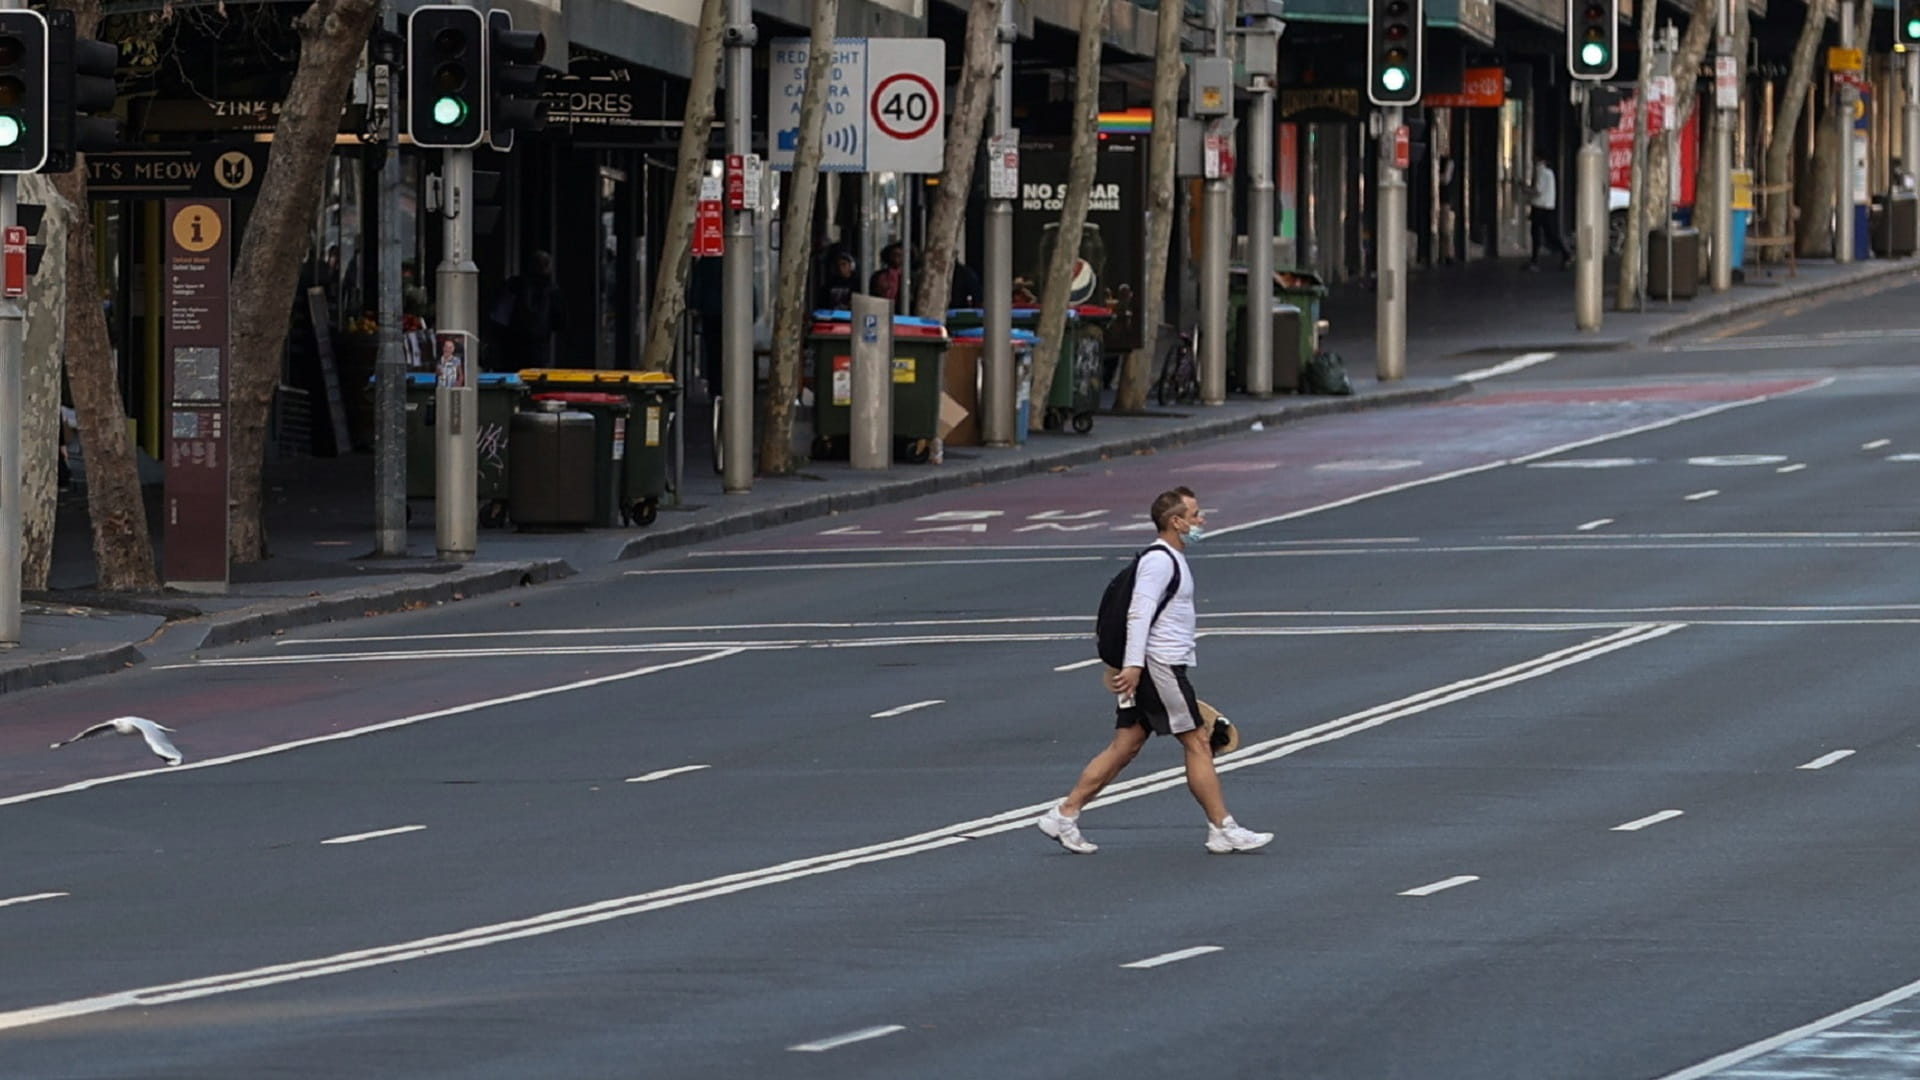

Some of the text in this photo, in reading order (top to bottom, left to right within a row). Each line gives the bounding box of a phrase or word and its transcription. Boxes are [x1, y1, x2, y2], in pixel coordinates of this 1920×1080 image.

[777, 51, 807, 64] RED
[784, 85, 849, 97] CARA
[215, 101, 267, 116] ZINK
[790, 102, 845, 115] AAD
[882, 92, 927, 122] 40
[135, 161, 202, 180] MEOW
[1023, 184, 1120, 199] NO SAR
[1023, 200, 1120, 211] NO COOMISE
